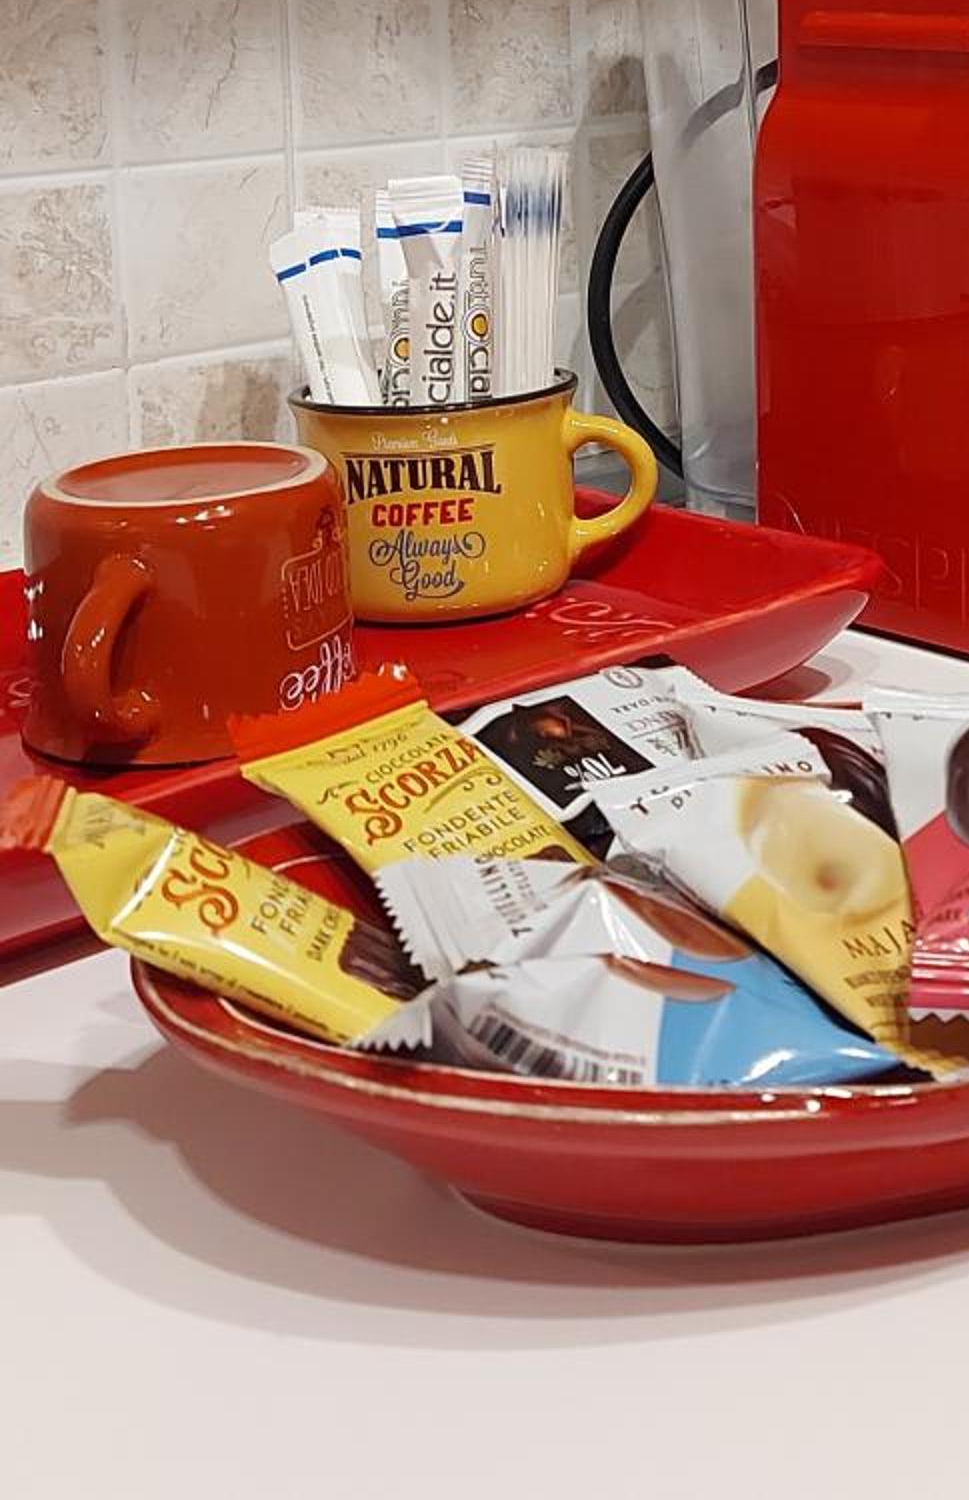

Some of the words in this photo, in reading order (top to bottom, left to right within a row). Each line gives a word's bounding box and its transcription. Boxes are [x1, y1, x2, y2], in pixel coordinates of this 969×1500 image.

[343, 450, 502, 505] NATURAL
[371, 498, 475, 528] COFFEE
[369, 527, 486, 567] Always
[390, 560, 466, 601] Good
[344, 736, 486, 847] SCORZA
[403, 788, 520, 854] FONDENTE
[428, 806, 527, 860] FRIABILE
[841, 920, 917, 959] MAJA
